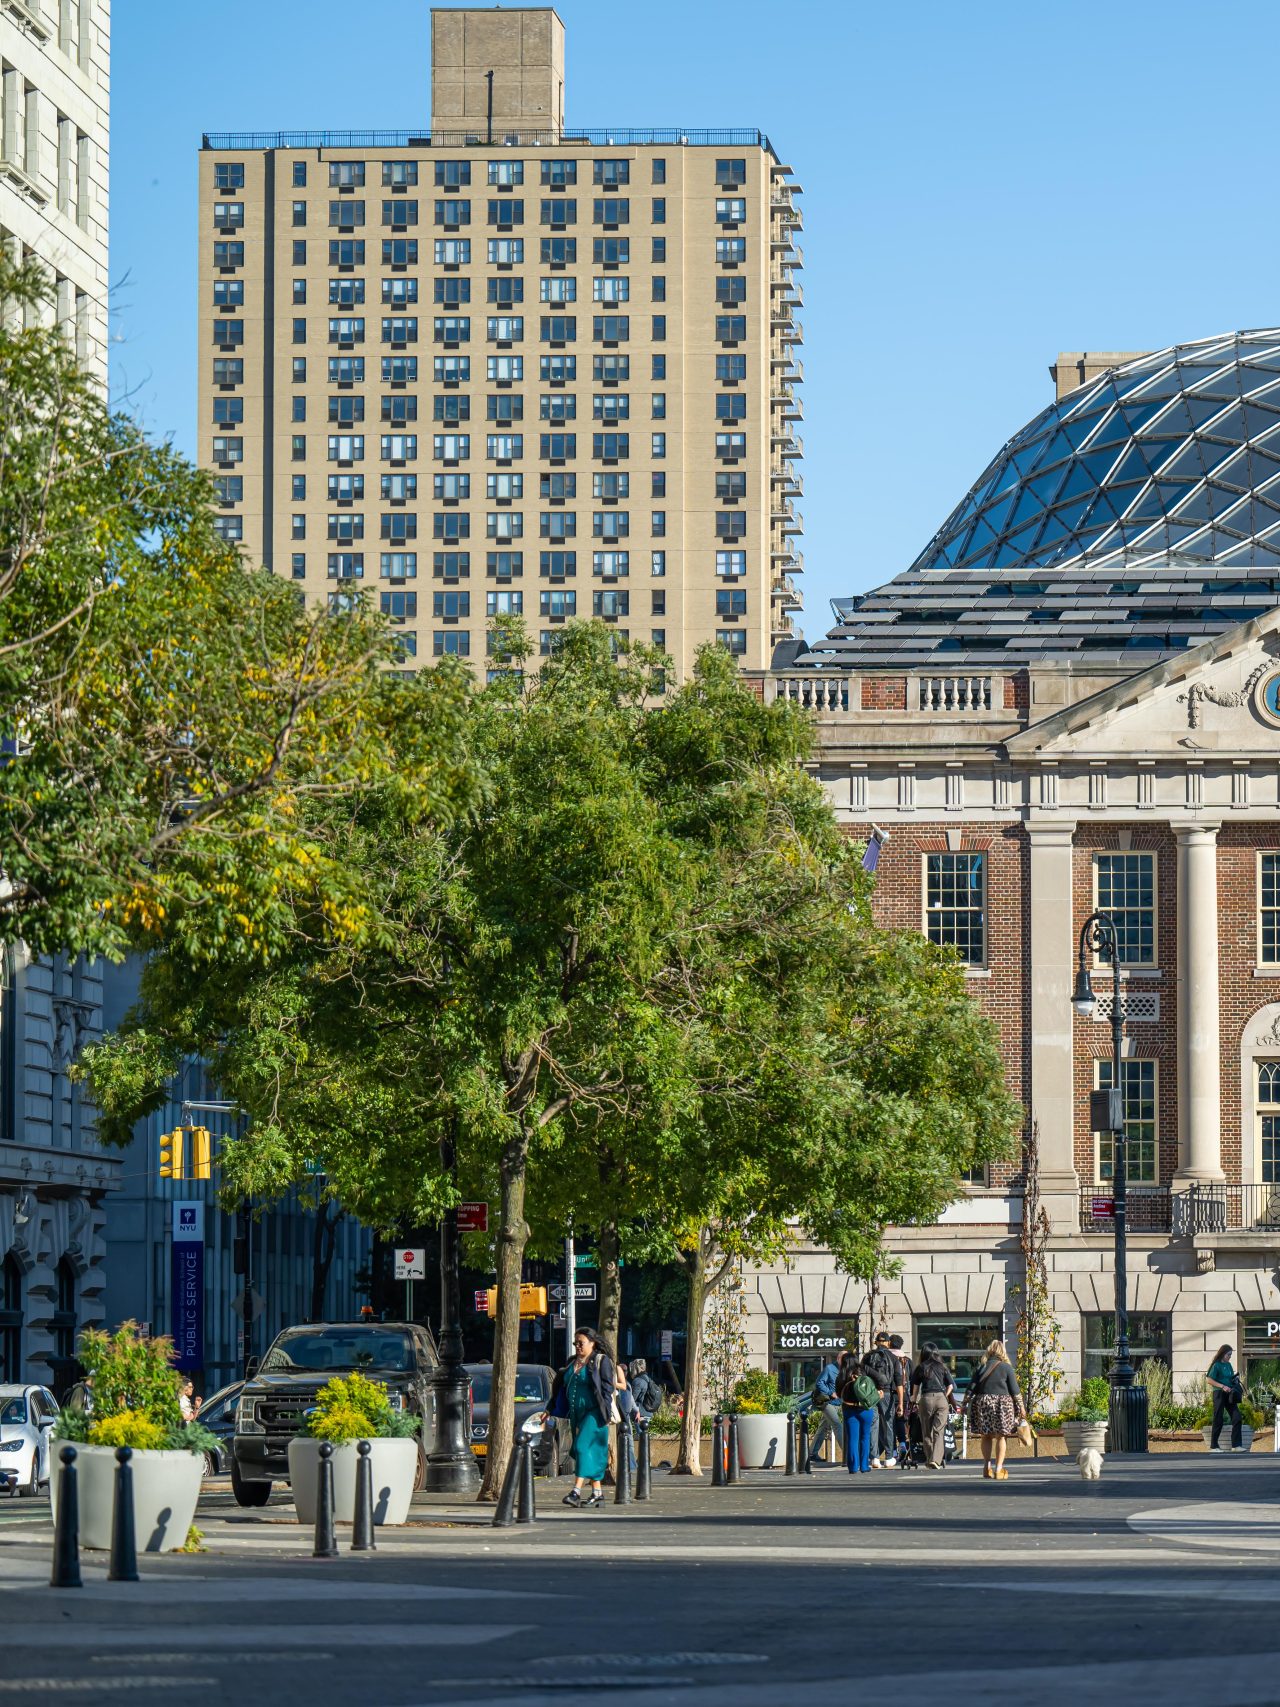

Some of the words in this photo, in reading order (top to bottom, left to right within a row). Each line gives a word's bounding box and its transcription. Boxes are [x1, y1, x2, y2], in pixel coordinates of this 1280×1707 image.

[186, 1251, 196, 1306] SERVICE
[575, 1288, 589, 1296] WAY
[186, 1310, 196, 1356] PUBLIC
[780, 1322, 820, 1334] vetco
[780, 1335, 814, 1347] total
[816, 1337, 847, 1347] care
